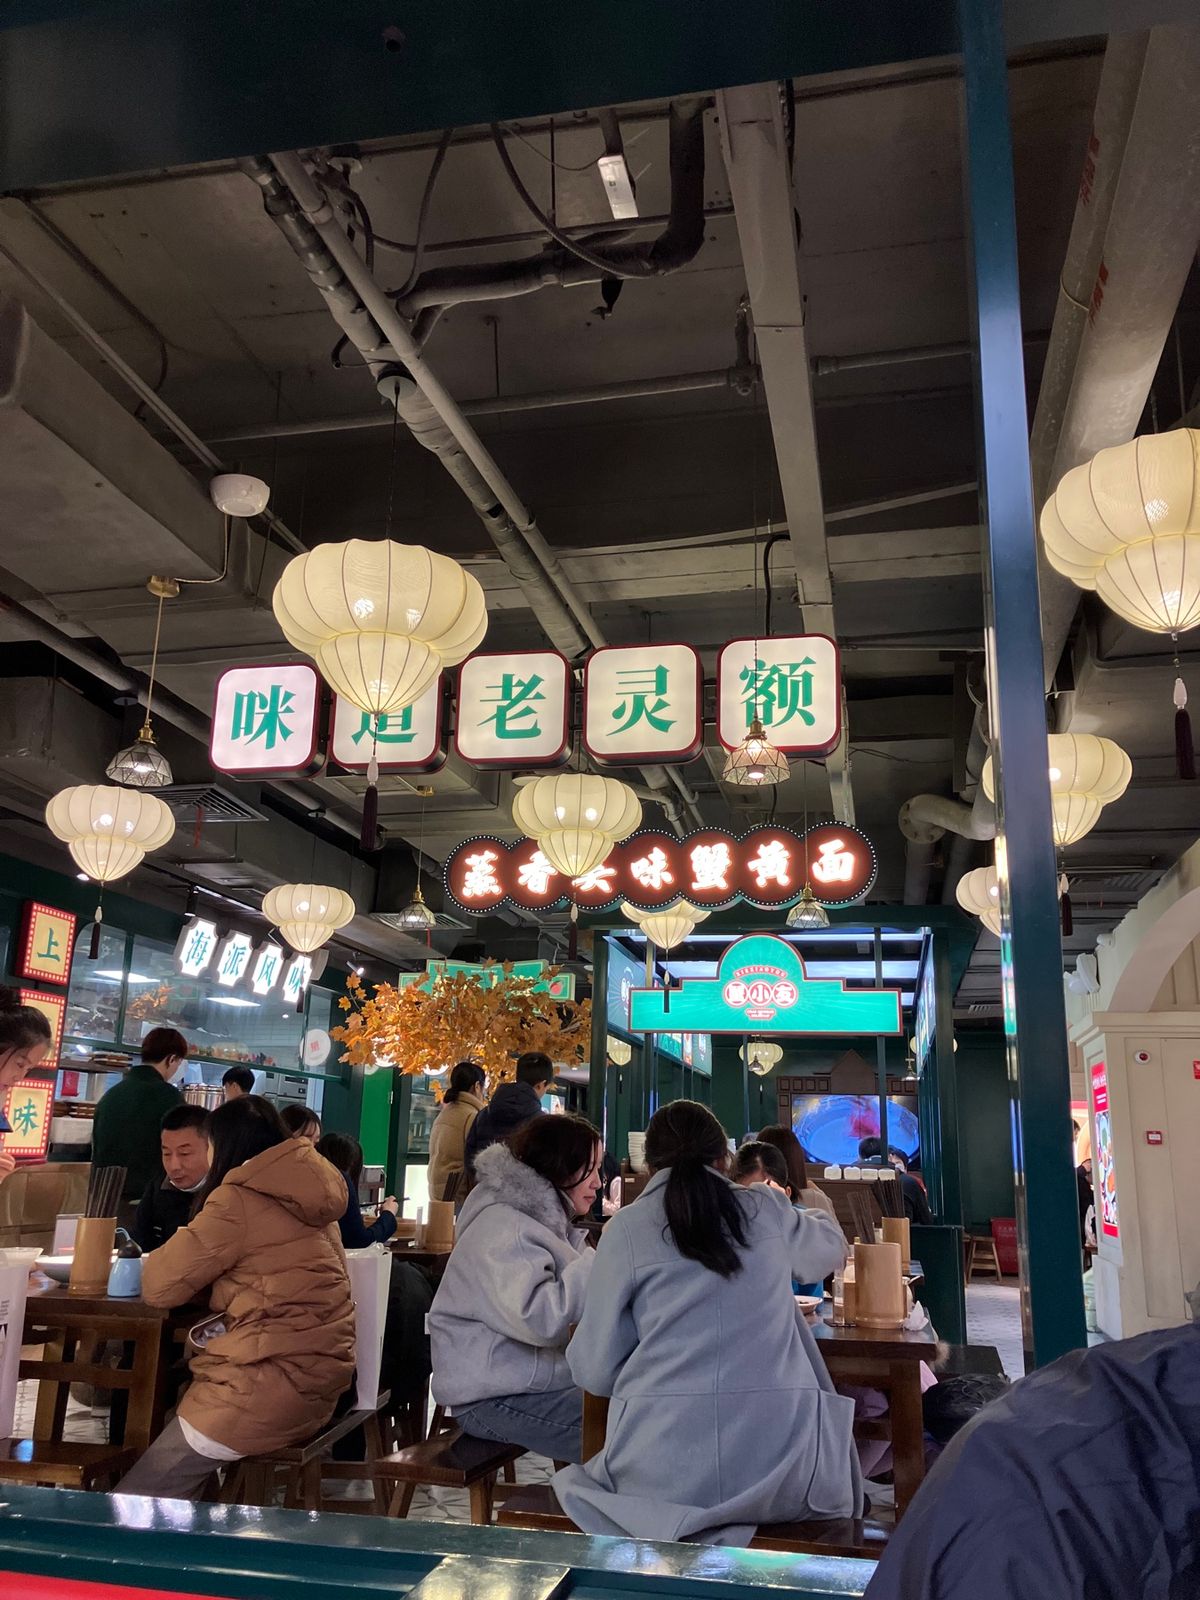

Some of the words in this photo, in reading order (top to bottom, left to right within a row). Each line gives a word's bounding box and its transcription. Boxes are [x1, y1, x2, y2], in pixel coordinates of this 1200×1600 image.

[184, 929, 307, 995] 海派风味
[12, 926, 62, 1137] 上味
